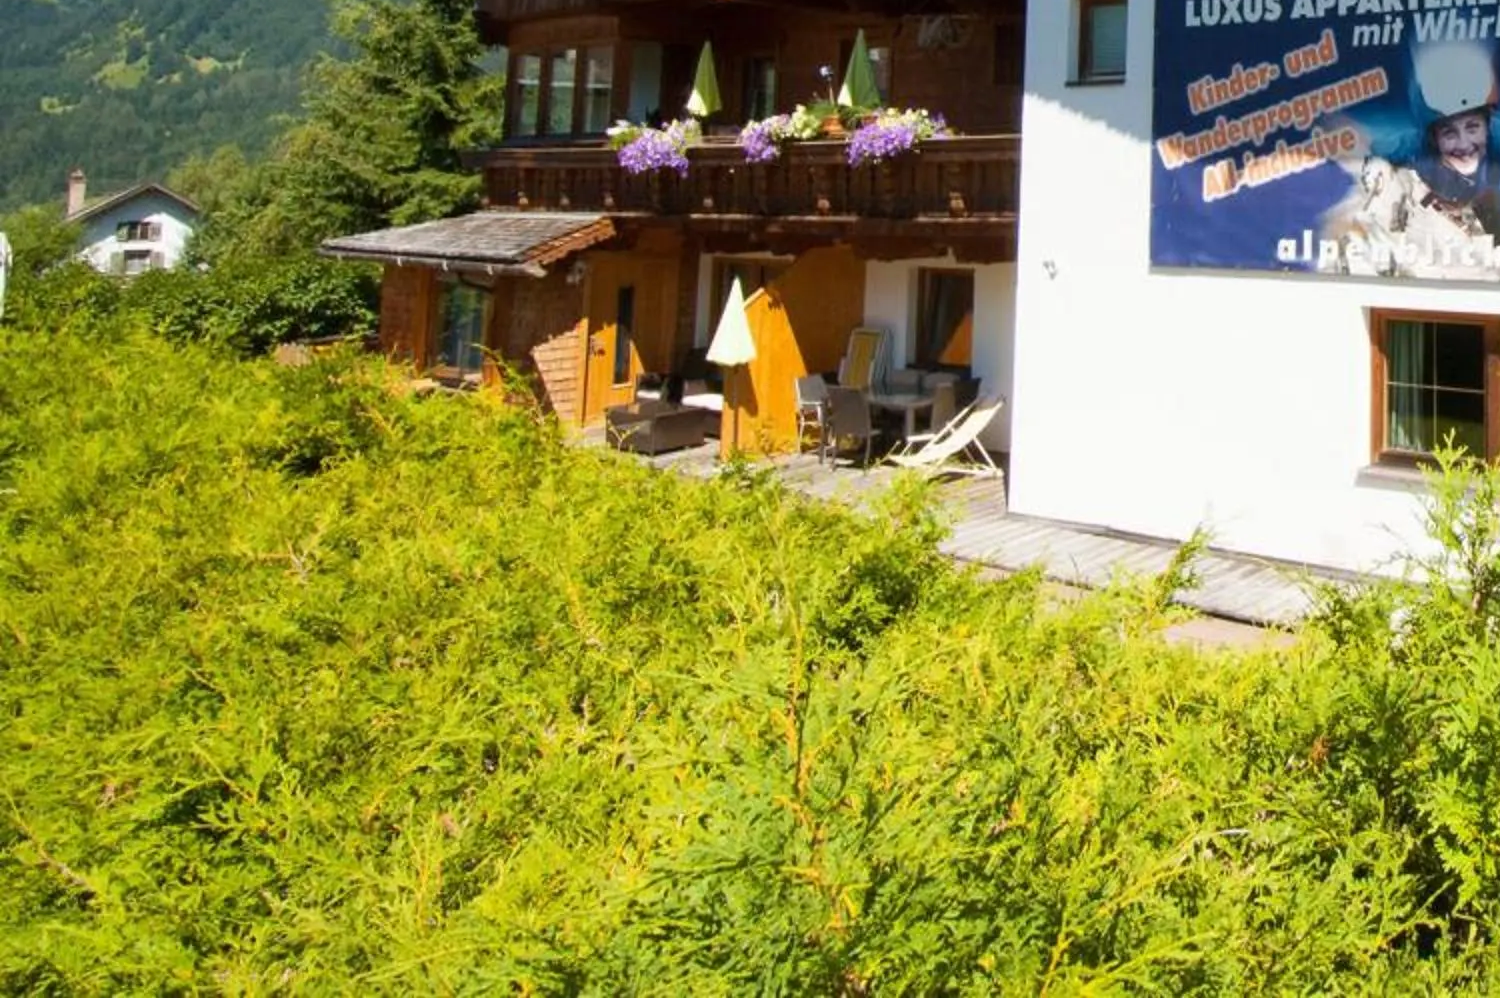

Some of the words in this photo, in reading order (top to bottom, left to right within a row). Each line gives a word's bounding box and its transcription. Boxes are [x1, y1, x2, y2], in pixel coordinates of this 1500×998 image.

[1284, 28, 1338, 78] und
[1351, 12, 1404, 46] mit
[1157, 67, 1389, 170] Wanderprogramm
